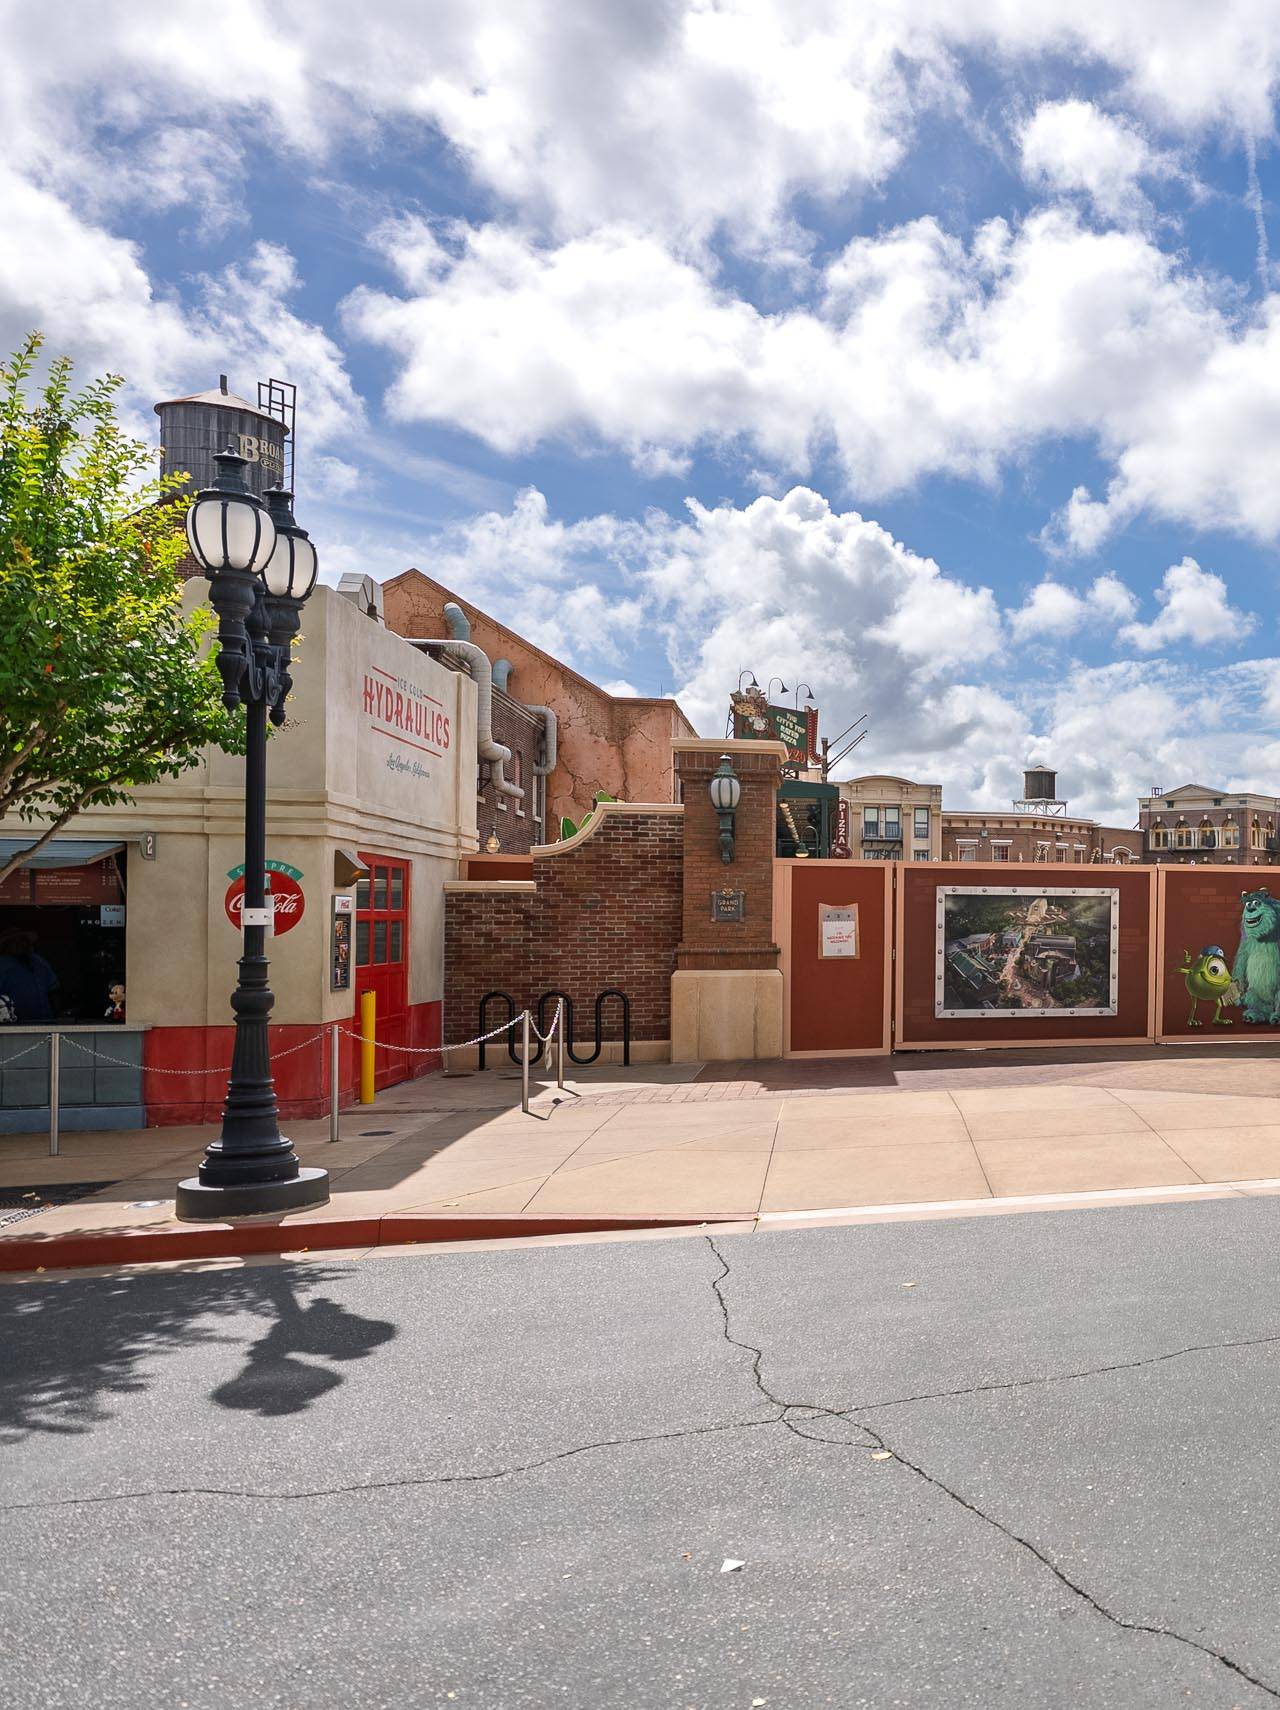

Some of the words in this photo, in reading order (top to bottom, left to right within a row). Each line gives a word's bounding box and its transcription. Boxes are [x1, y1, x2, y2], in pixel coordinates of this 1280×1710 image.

[239, 434, 282, 462] BROA
[397, 677, 407, 691] ICE
[409, 684, 424, 699] COLD
[363, 675, 450, 749] HYDRAULICS
[780, 732, 797, 746] PIZZA
[838, 803, 846, 844] PIZZA
[146, 835, 154, 855] 2
[237, 862, 294, 876] SPRE
